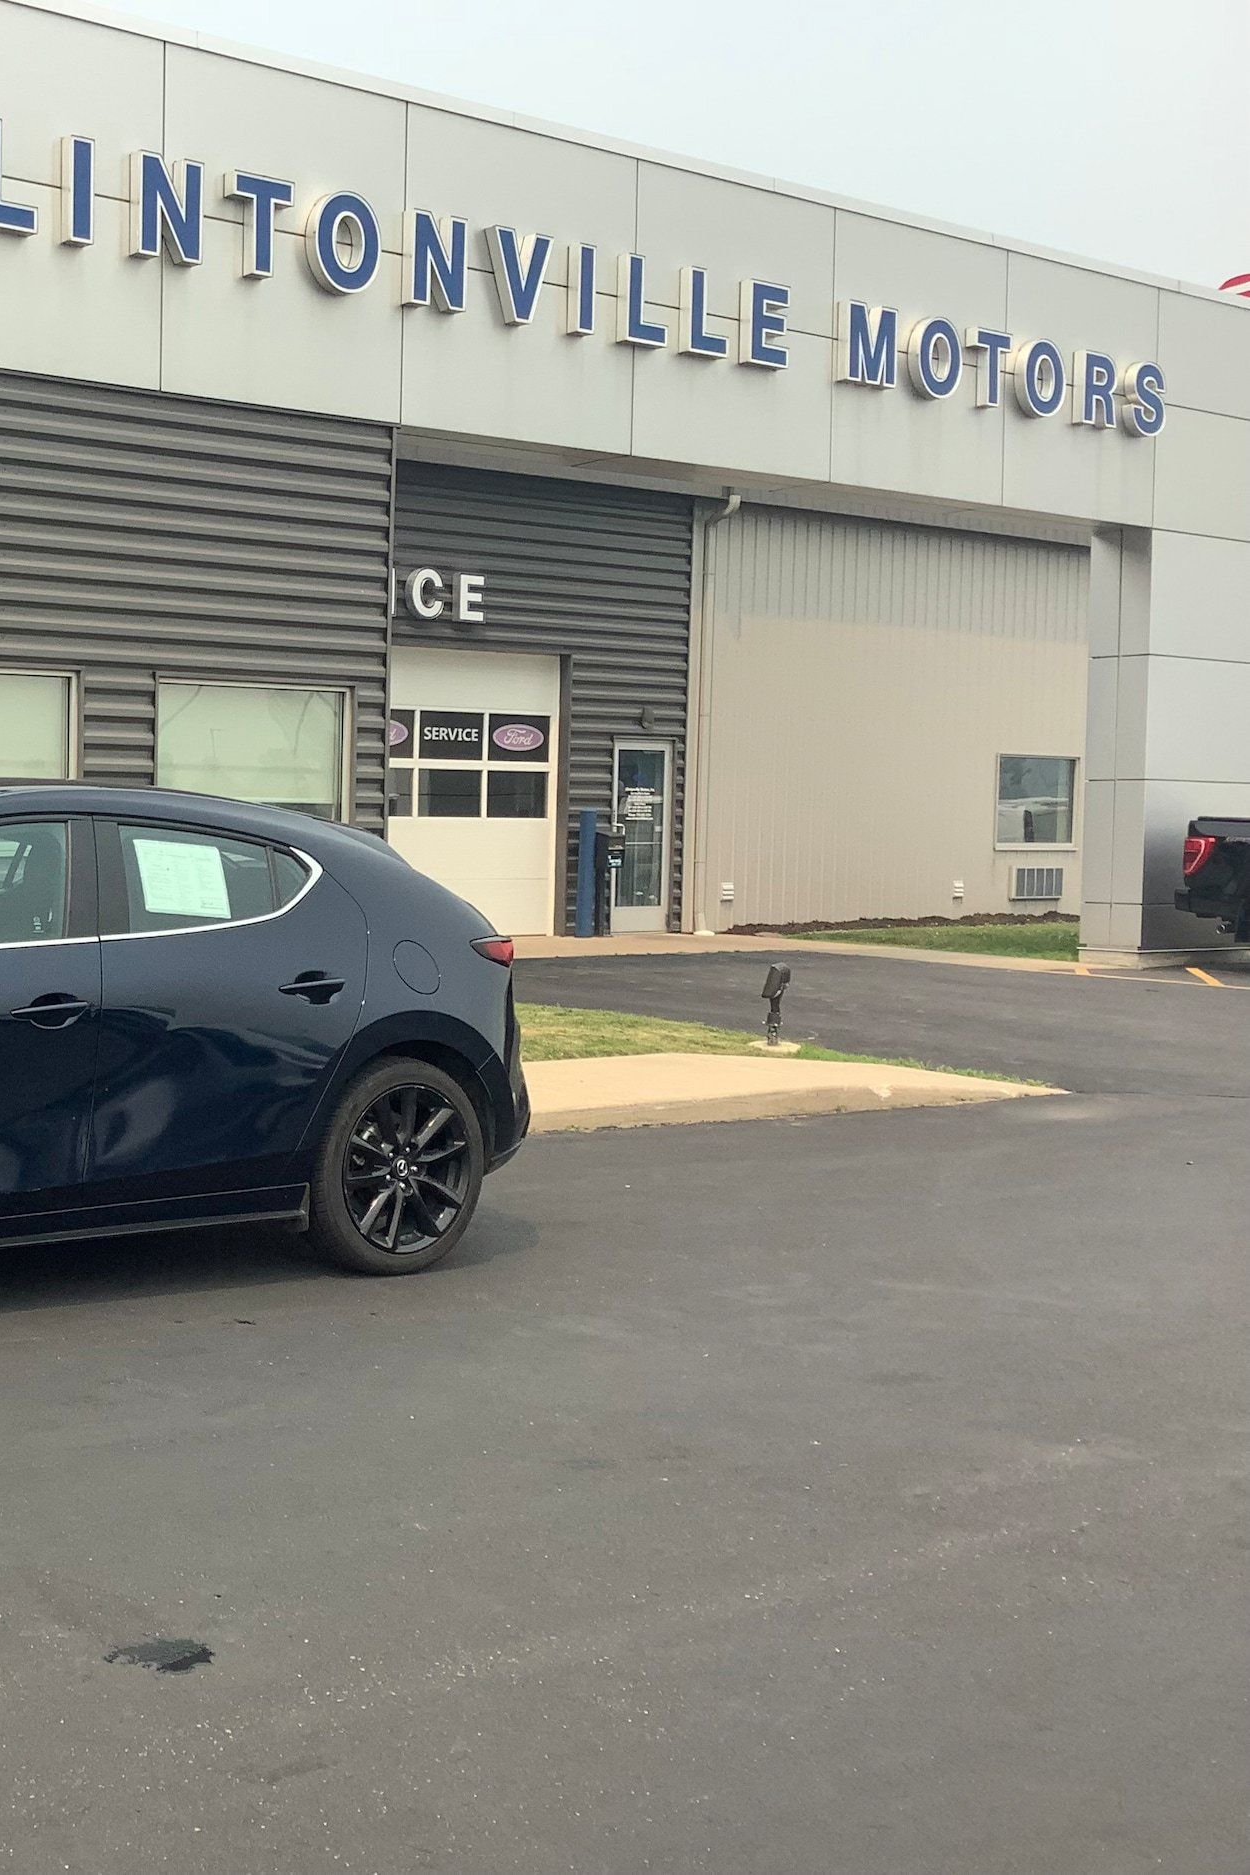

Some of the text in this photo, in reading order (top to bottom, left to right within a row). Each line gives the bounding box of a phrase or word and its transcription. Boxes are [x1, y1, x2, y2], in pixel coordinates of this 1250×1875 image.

[837, 299, 1166, 438] MOTORS
[423, 726, 479, 742] SERVICE
[503, 728, 533, 746] Ford
